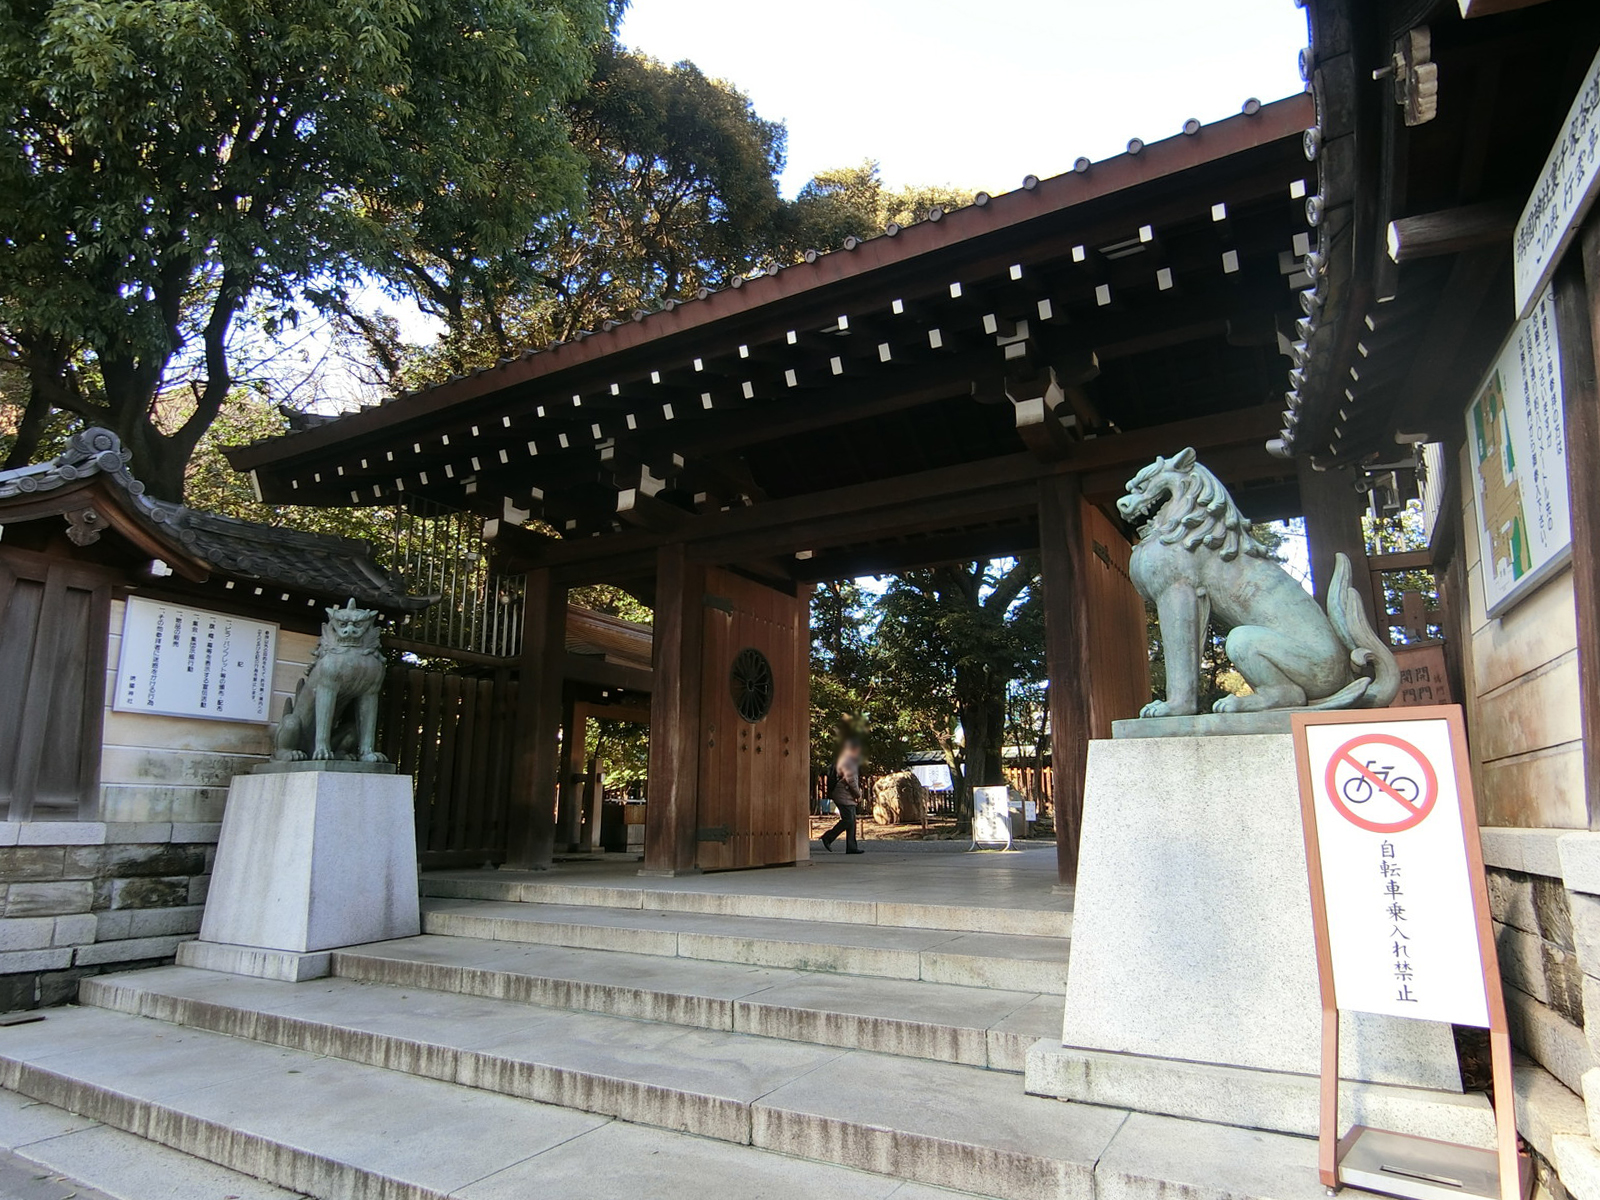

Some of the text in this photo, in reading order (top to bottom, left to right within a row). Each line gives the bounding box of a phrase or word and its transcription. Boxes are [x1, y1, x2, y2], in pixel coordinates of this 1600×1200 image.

[1379, 839, 1419, 1003] 自転車乗入れ禁止
